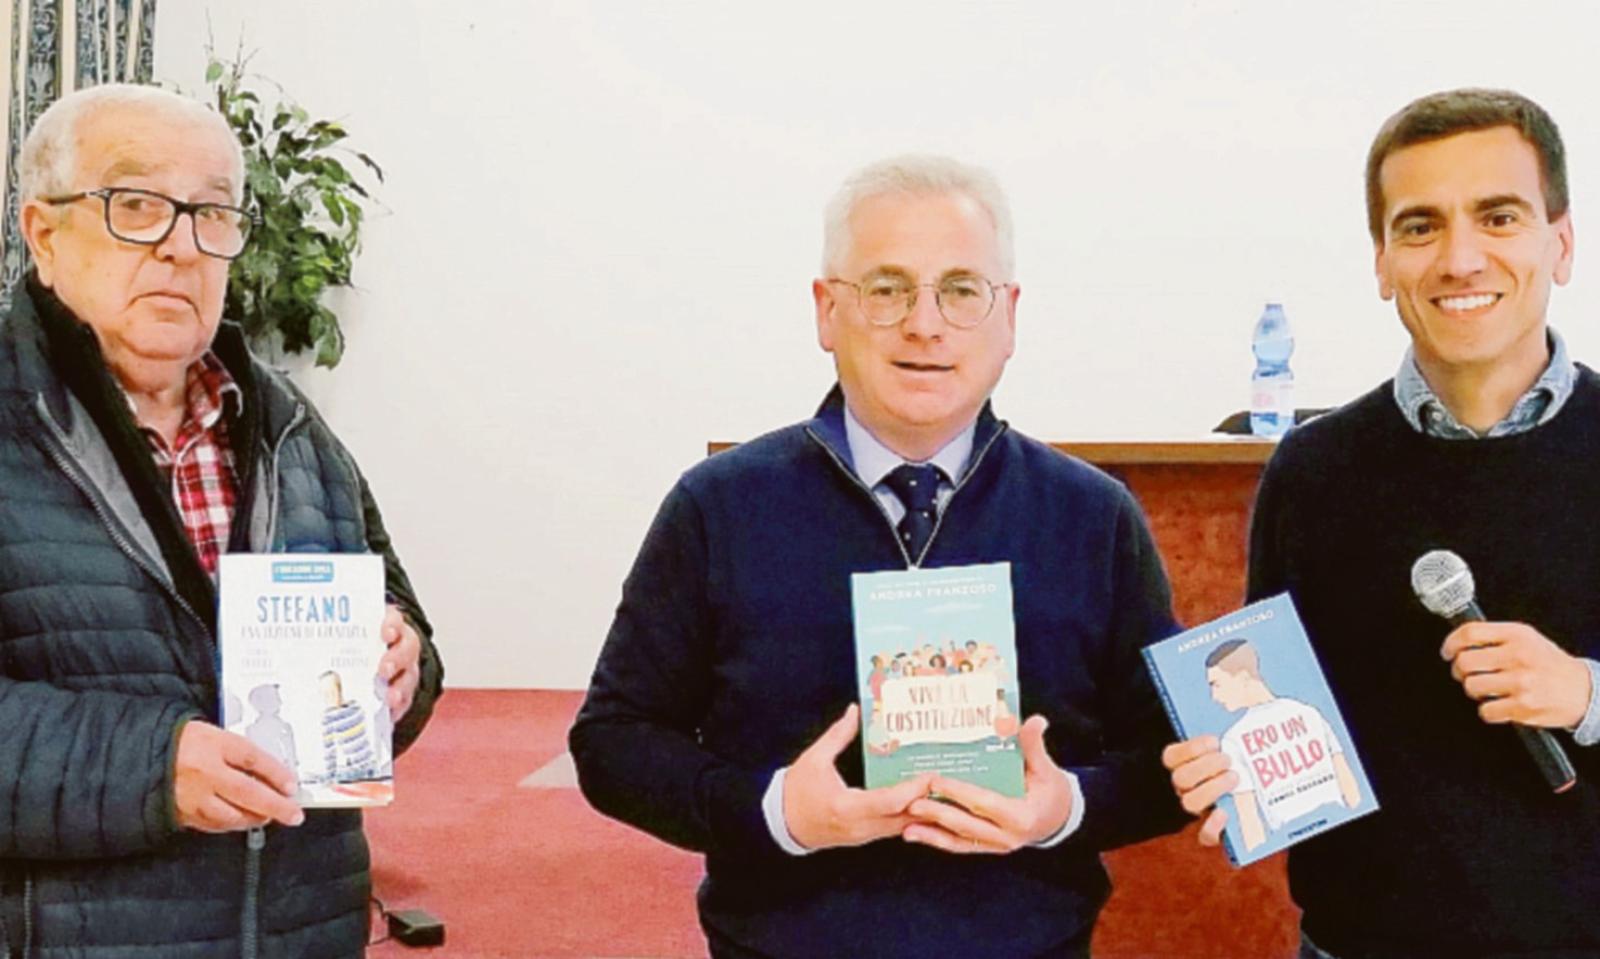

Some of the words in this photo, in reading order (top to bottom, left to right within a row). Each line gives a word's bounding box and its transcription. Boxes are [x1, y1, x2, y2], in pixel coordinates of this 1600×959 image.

[257, 595, 350, 623] STEFANO
[886, 704, 993, 732] COSTITUZIONE
[1241, 723, 1279, 755] ERO
[1280, 715, 1308, 740] UN
[1252, 739, 1325, 789] BULLO
